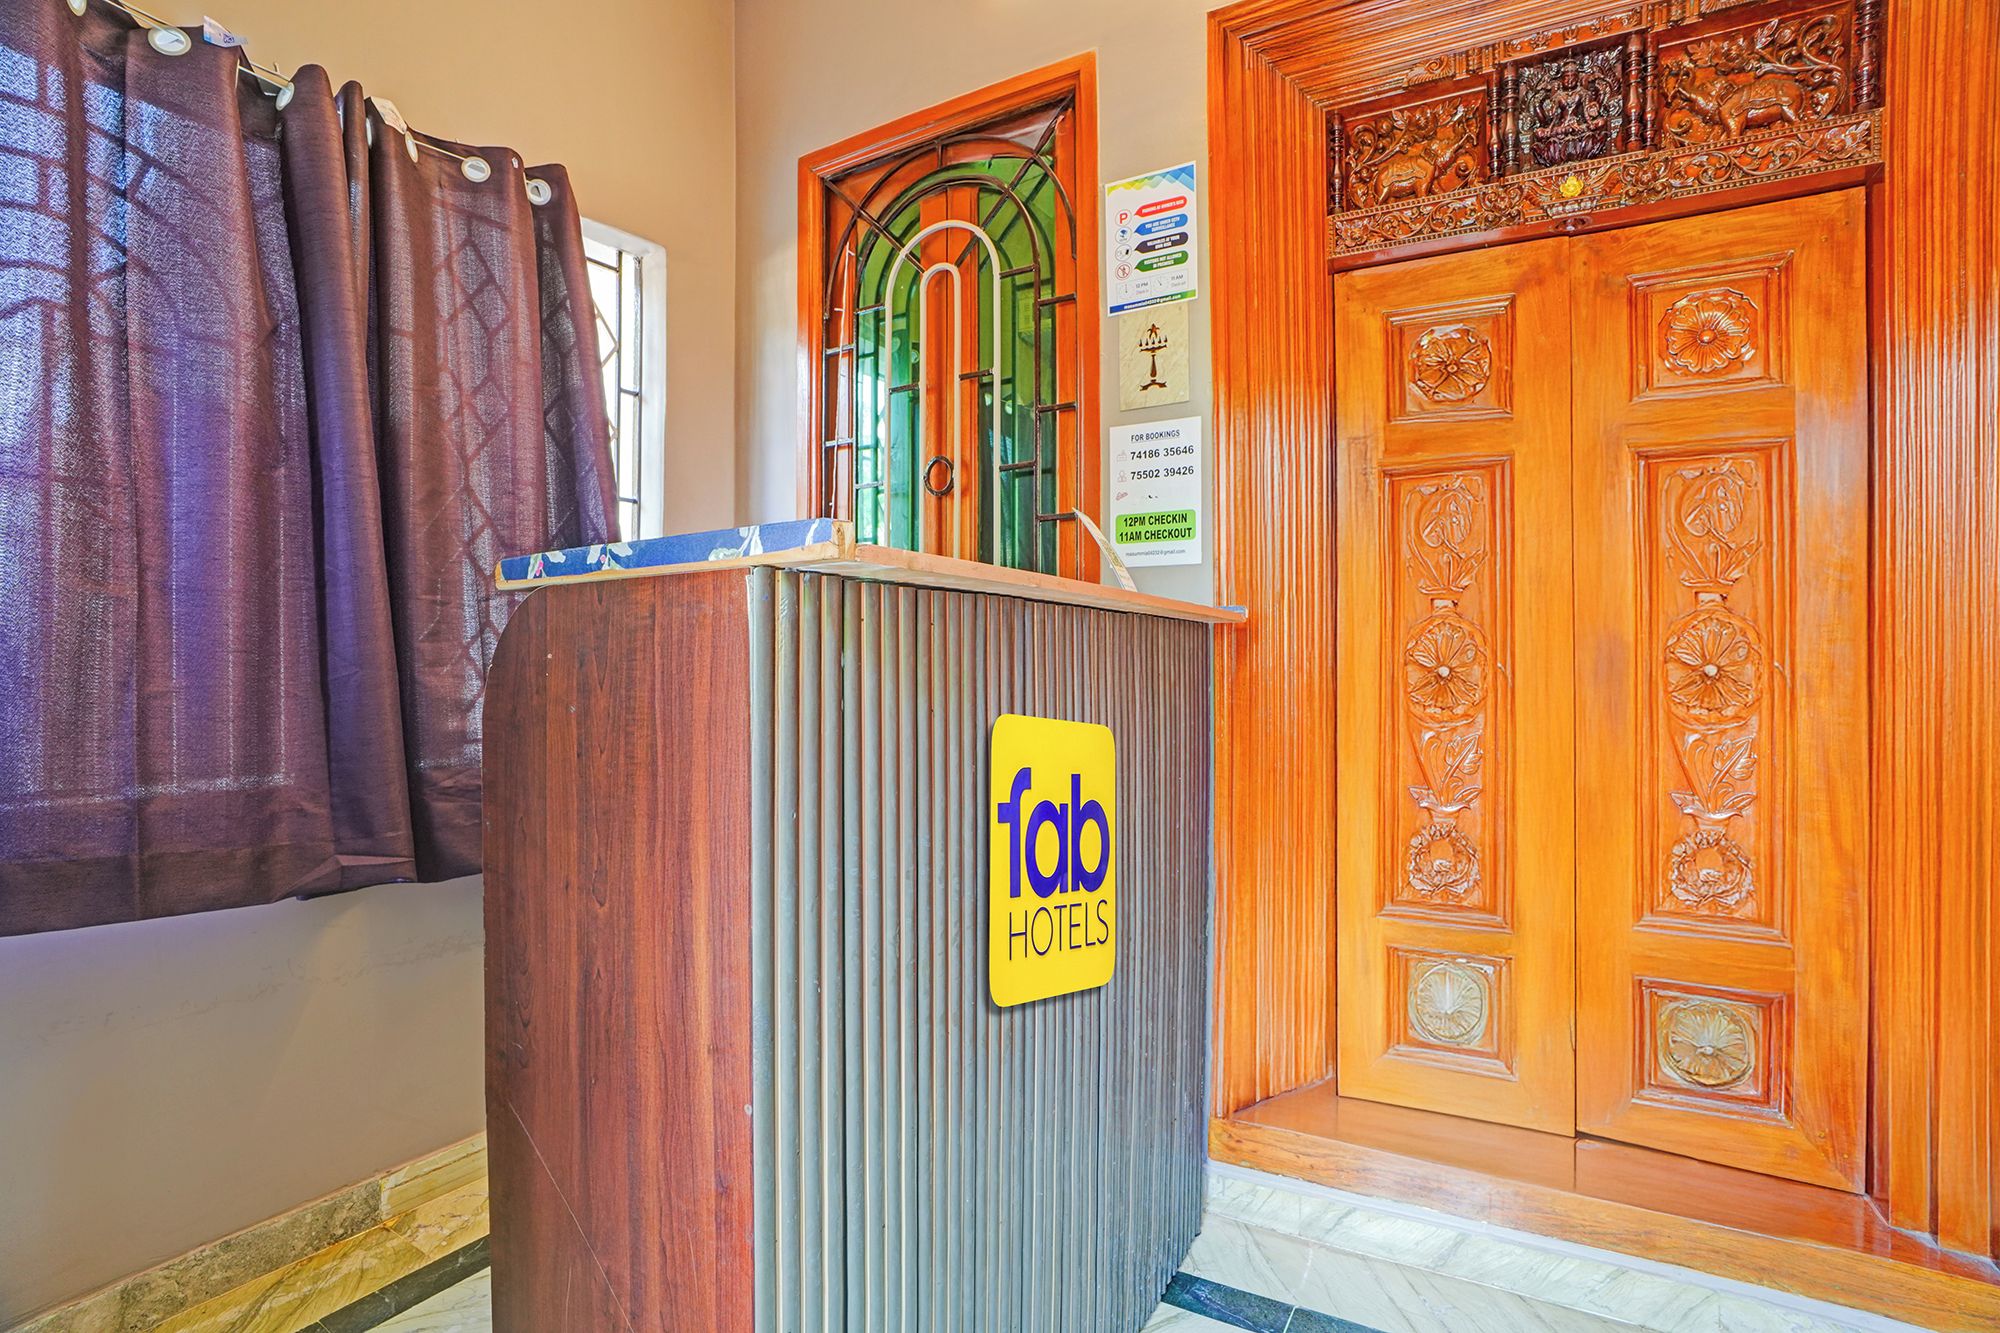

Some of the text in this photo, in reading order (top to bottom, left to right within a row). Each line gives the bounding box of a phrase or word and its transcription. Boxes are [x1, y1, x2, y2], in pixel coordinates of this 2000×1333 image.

[1119, 212, 1128, 224] P
[1131, 429, 1180, 442] FOR BOOKINGS
[1130, 445, 1194, 460] 74186 35646
[1130, 465, 1194, 480] 75502 39426
[1123, 513, 1188, 527] 12PM CHECKIN
[1119, 528, 1192, 542] 11AM CHECKOUT
[998, 767, 1110, 898] fab
[1009, 899, 1109, 961] HOTELS
